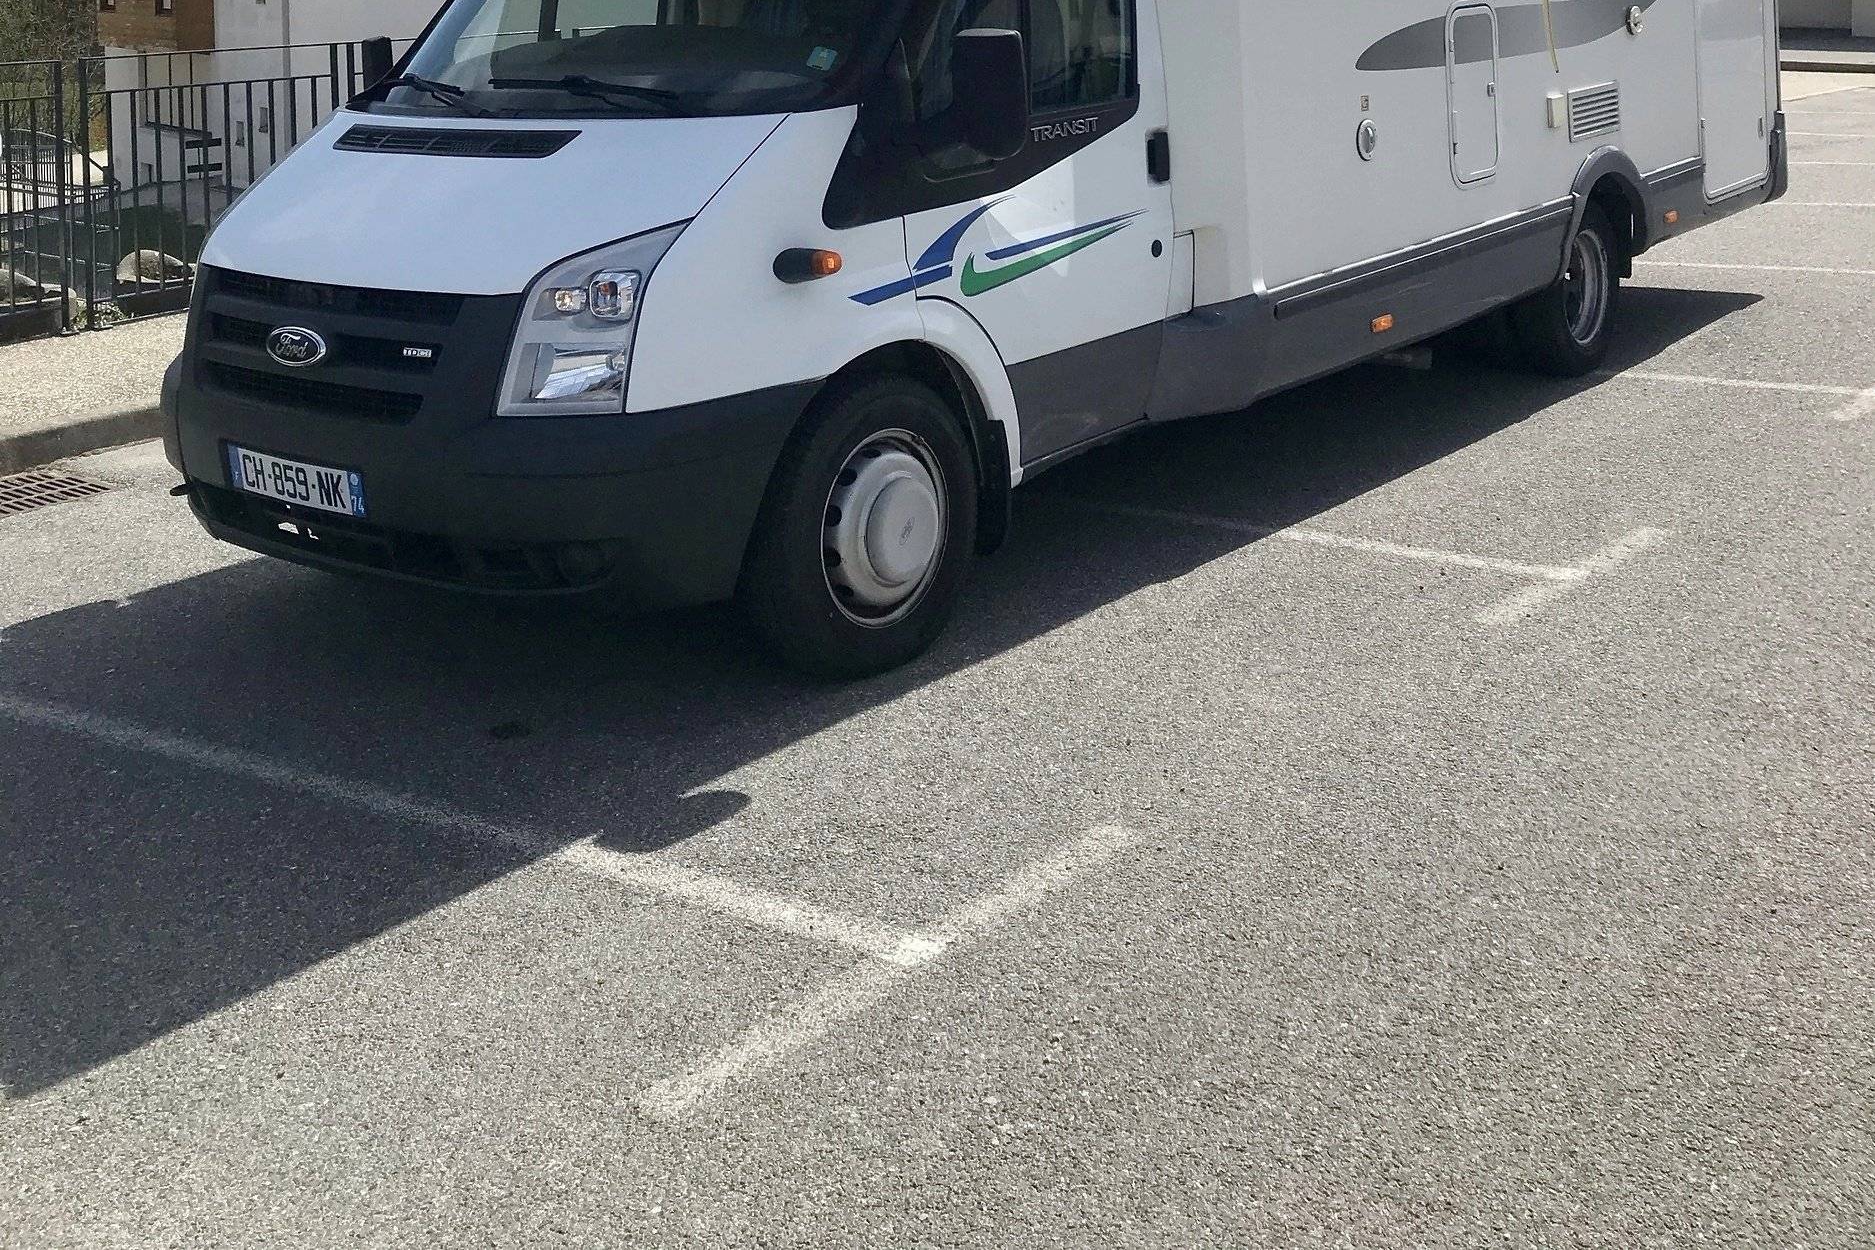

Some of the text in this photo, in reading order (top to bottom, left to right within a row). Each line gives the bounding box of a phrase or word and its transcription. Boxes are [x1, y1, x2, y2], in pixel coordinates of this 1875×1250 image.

[1030, 116, 1099, 142] TRANSIT
[276, 333, 309, 359] Ford
[242, 453, 347, 509] CH-859-NK
[351, 495, 365, 514] 74
